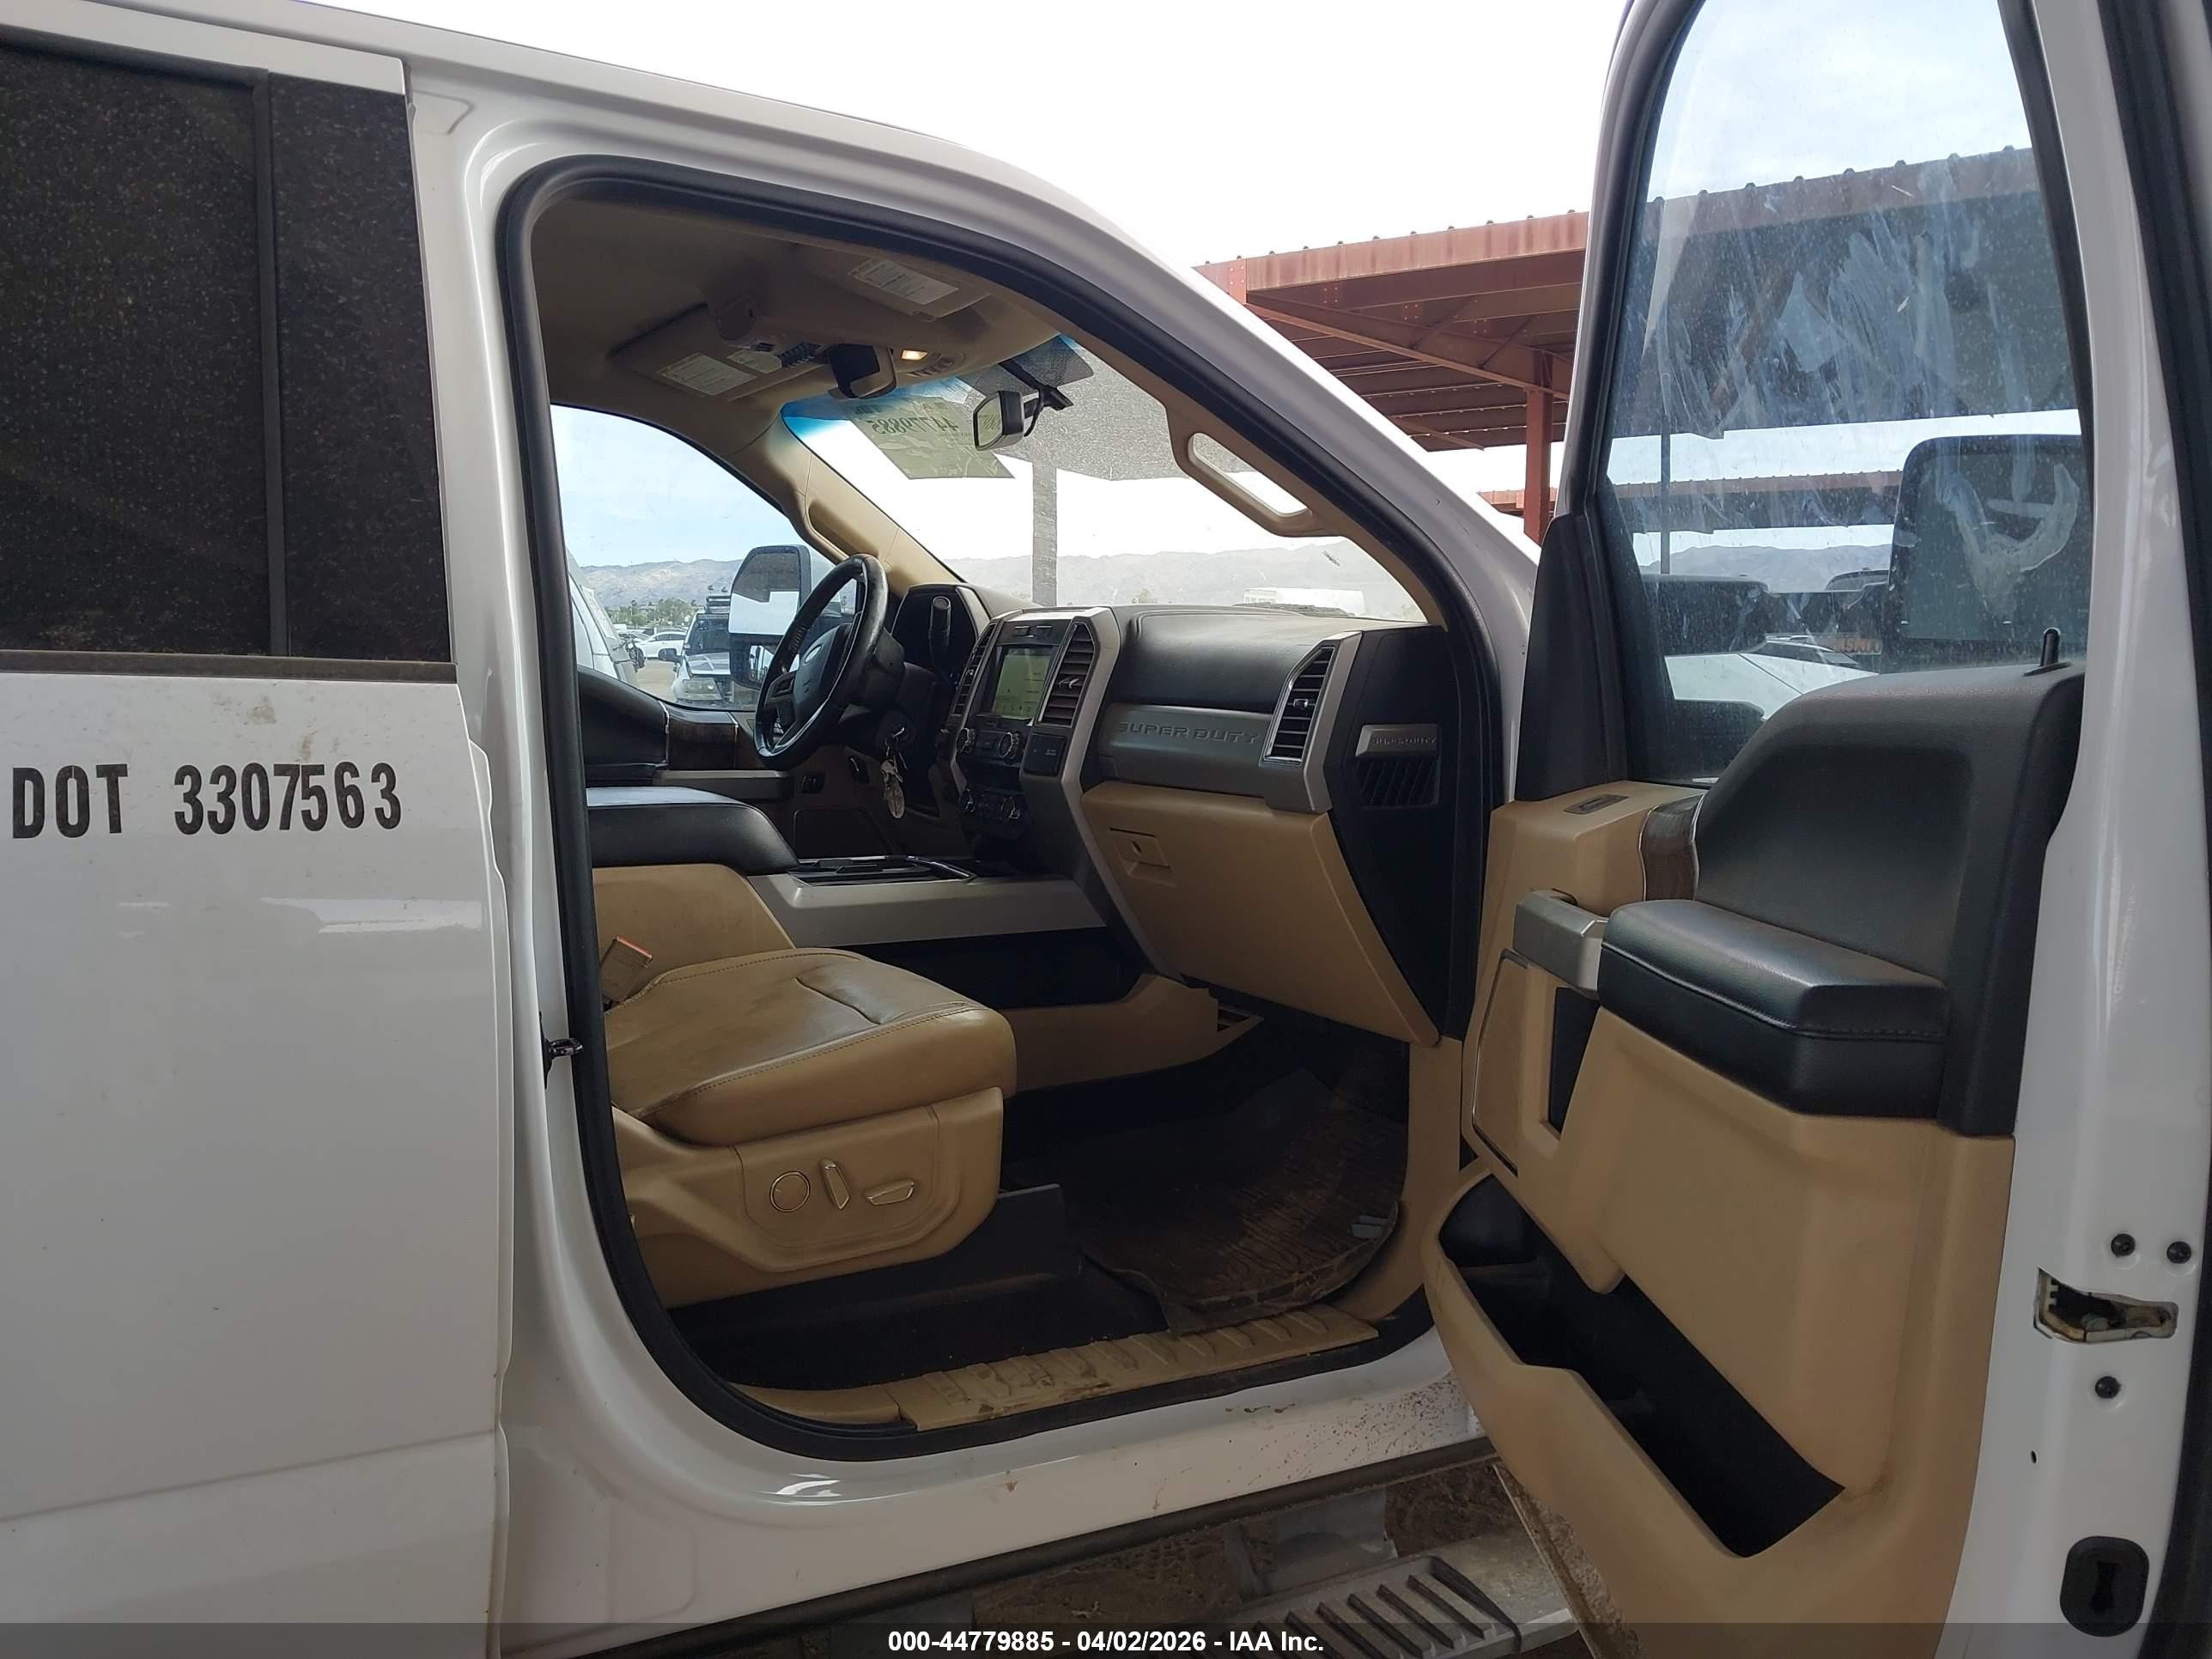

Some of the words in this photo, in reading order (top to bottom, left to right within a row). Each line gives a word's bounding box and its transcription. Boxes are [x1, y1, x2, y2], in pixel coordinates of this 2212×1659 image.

[1118, 721, 1189, 738] SUPER
[1194, 728, 1261, 744] DUTY
[12, 763, 129, 839] DOT
[173, 761, 402, 836] 3307563
